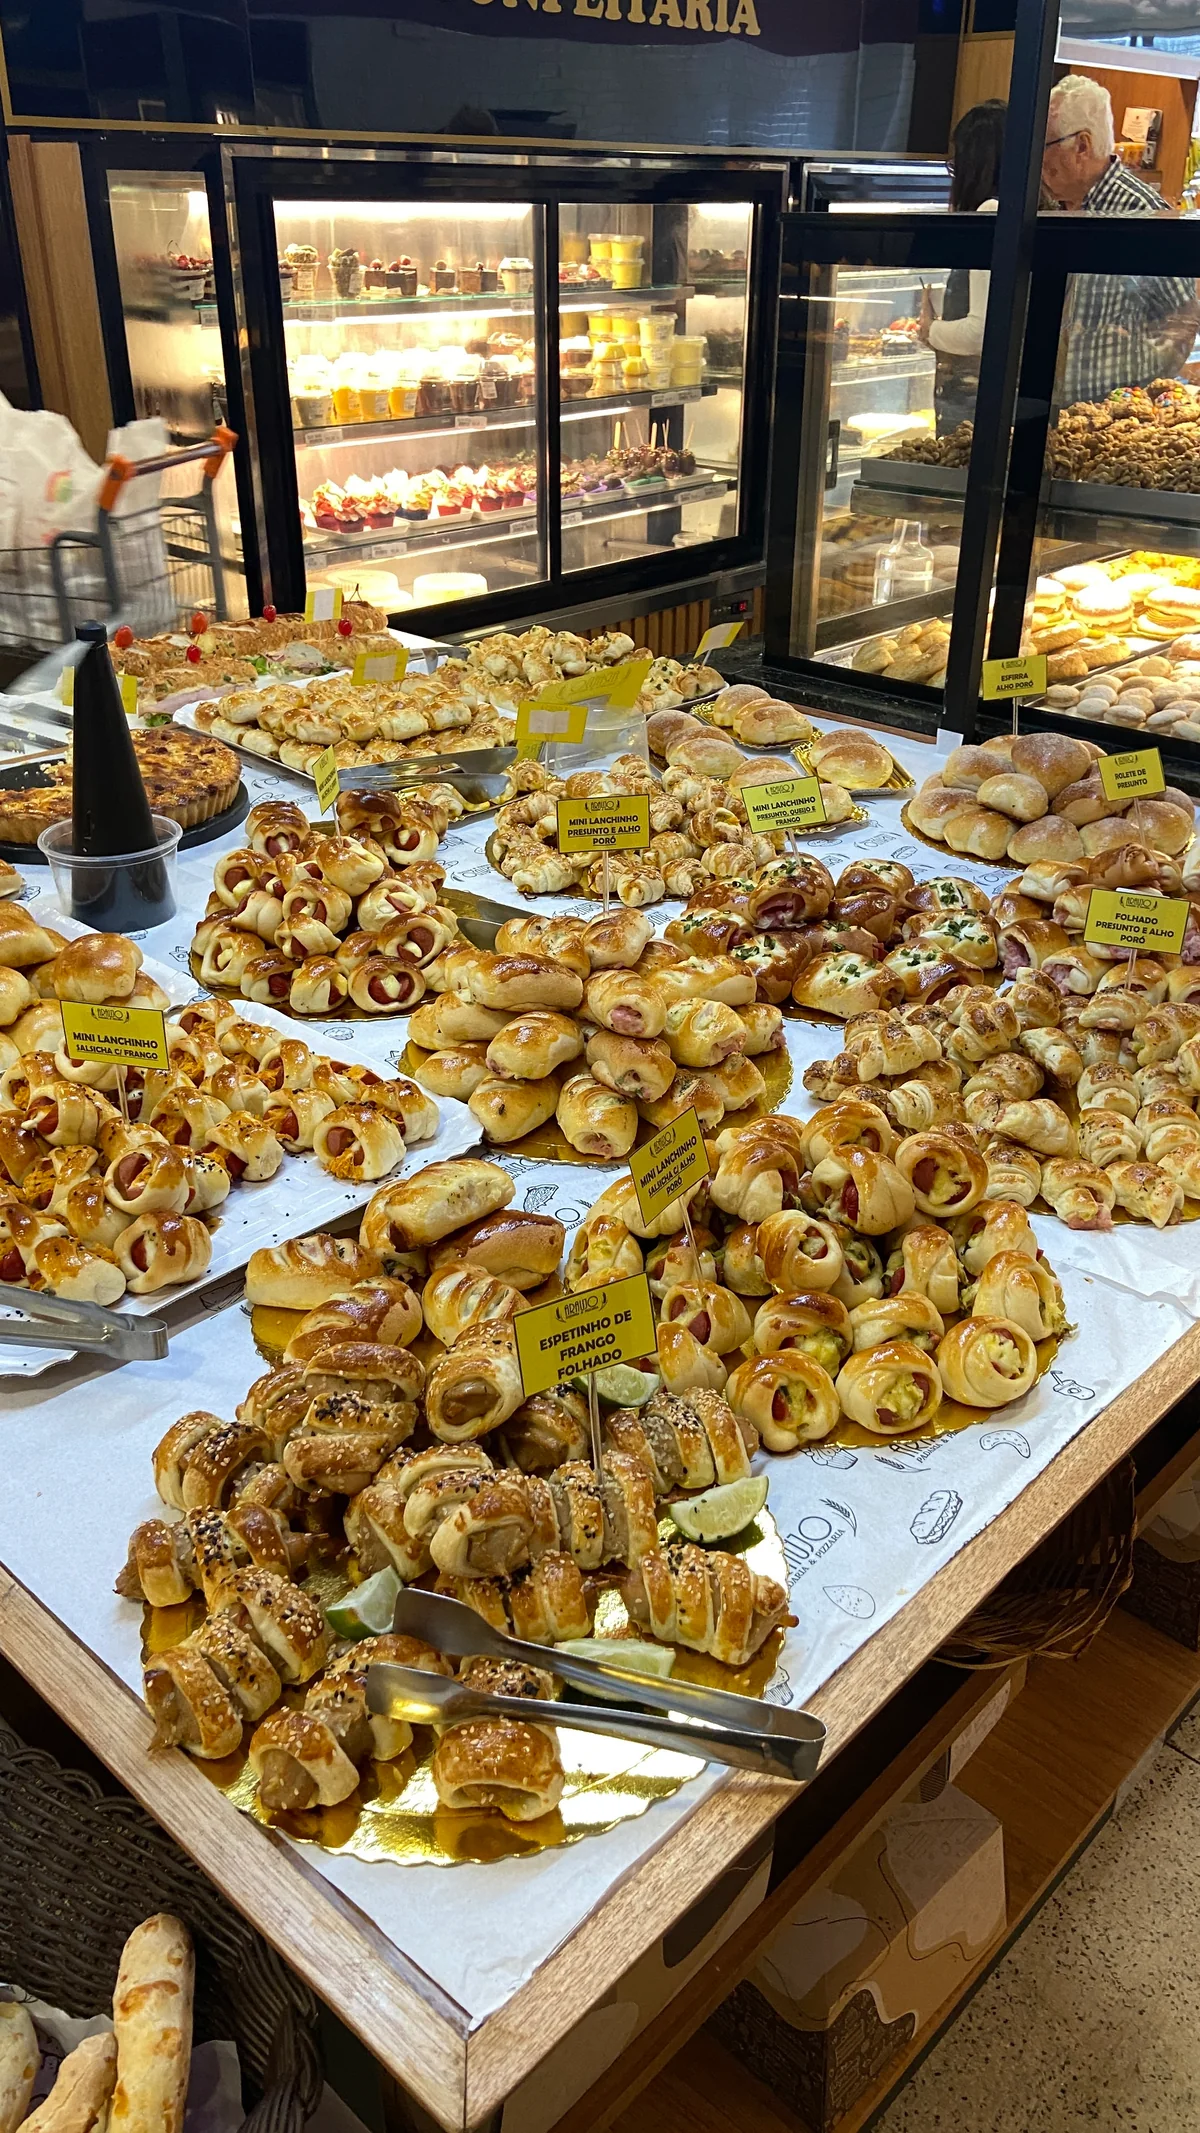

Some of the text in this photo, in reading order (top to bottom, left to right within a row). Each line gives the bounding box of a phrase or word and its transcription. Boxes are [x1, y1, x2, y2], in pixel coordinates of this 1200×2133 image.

[471, 0, 761, 36] EITARIA
[996, 680, 1034, 691] ALHO PORÓ
[1001, 673, 1029, 682] ESFIRRA
[1114, 768, 1147, 780] ROLETE DE
[1117, 778, 1148, 789] PRESUNTO
[752, 796, 816, 813] MINI LANCHINHO
[569, 815, 639, 826] MINI LANCHINHO
[776, 816, 801, 825] FRANGO
[567, 825, 641, 837] PRESUNTO E ALHO
[592, 836, 617, 845] PORÓ
[1115, 912, 1158, 925] FOLHADO
[1095, 920, 1141, 933] PRESUNTO
[1149, 928, 1175, 938] ALHO
[1120, 934, 1146, 944] PORÓ
[72, 1031, 158, 1049] MINI LANCHINHO
[76, 1044, 158, 1060] SALSICHA C/ FRANGO
[640, 1136, 697, 1189] MINI LANCHINHO
[648, 1152, 696, 1197] SALSICHA C/ ALHO
[666, 1175, 683, 1195] PORÓ
[539, 1309, 632, 1352] ESPETINHO DE
[560, 1333, 616, 1361] FRANGO
[557, 1348, 622, 1380] FOLHADO
[787, 1566, 810, 1589] DARIA
[815, 1528, 846, 1559] PIZZARIA
